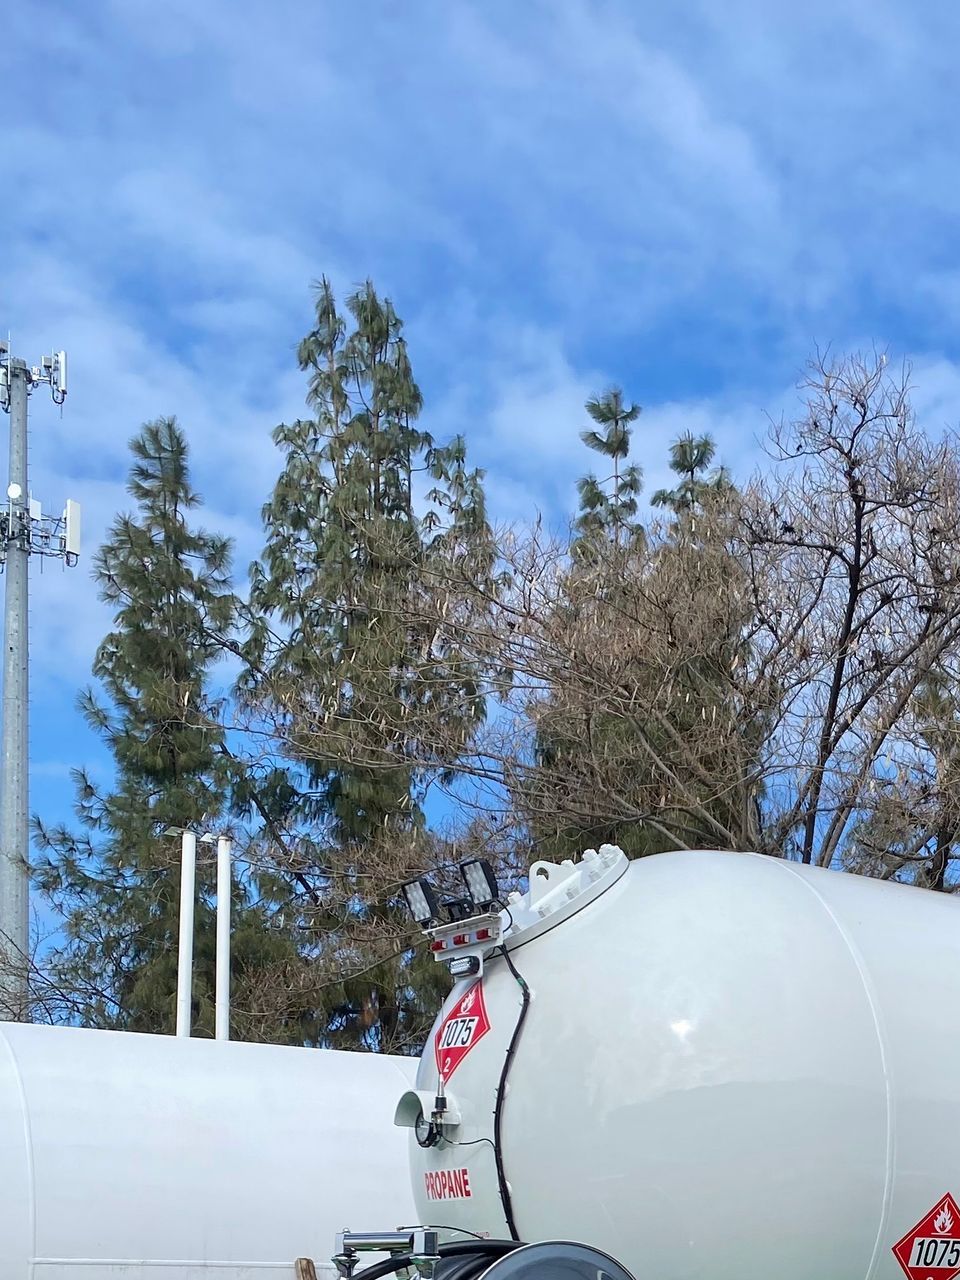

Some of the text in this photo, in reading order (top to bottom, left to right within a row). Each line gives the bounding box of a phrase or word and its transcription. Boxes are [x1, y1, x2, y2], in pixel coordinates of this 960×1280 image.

[441, 1019, 476, 1048] 1075
[443, 1057, 452, 1073] 2
[424, 1168, 471, 1200] PROPANE
